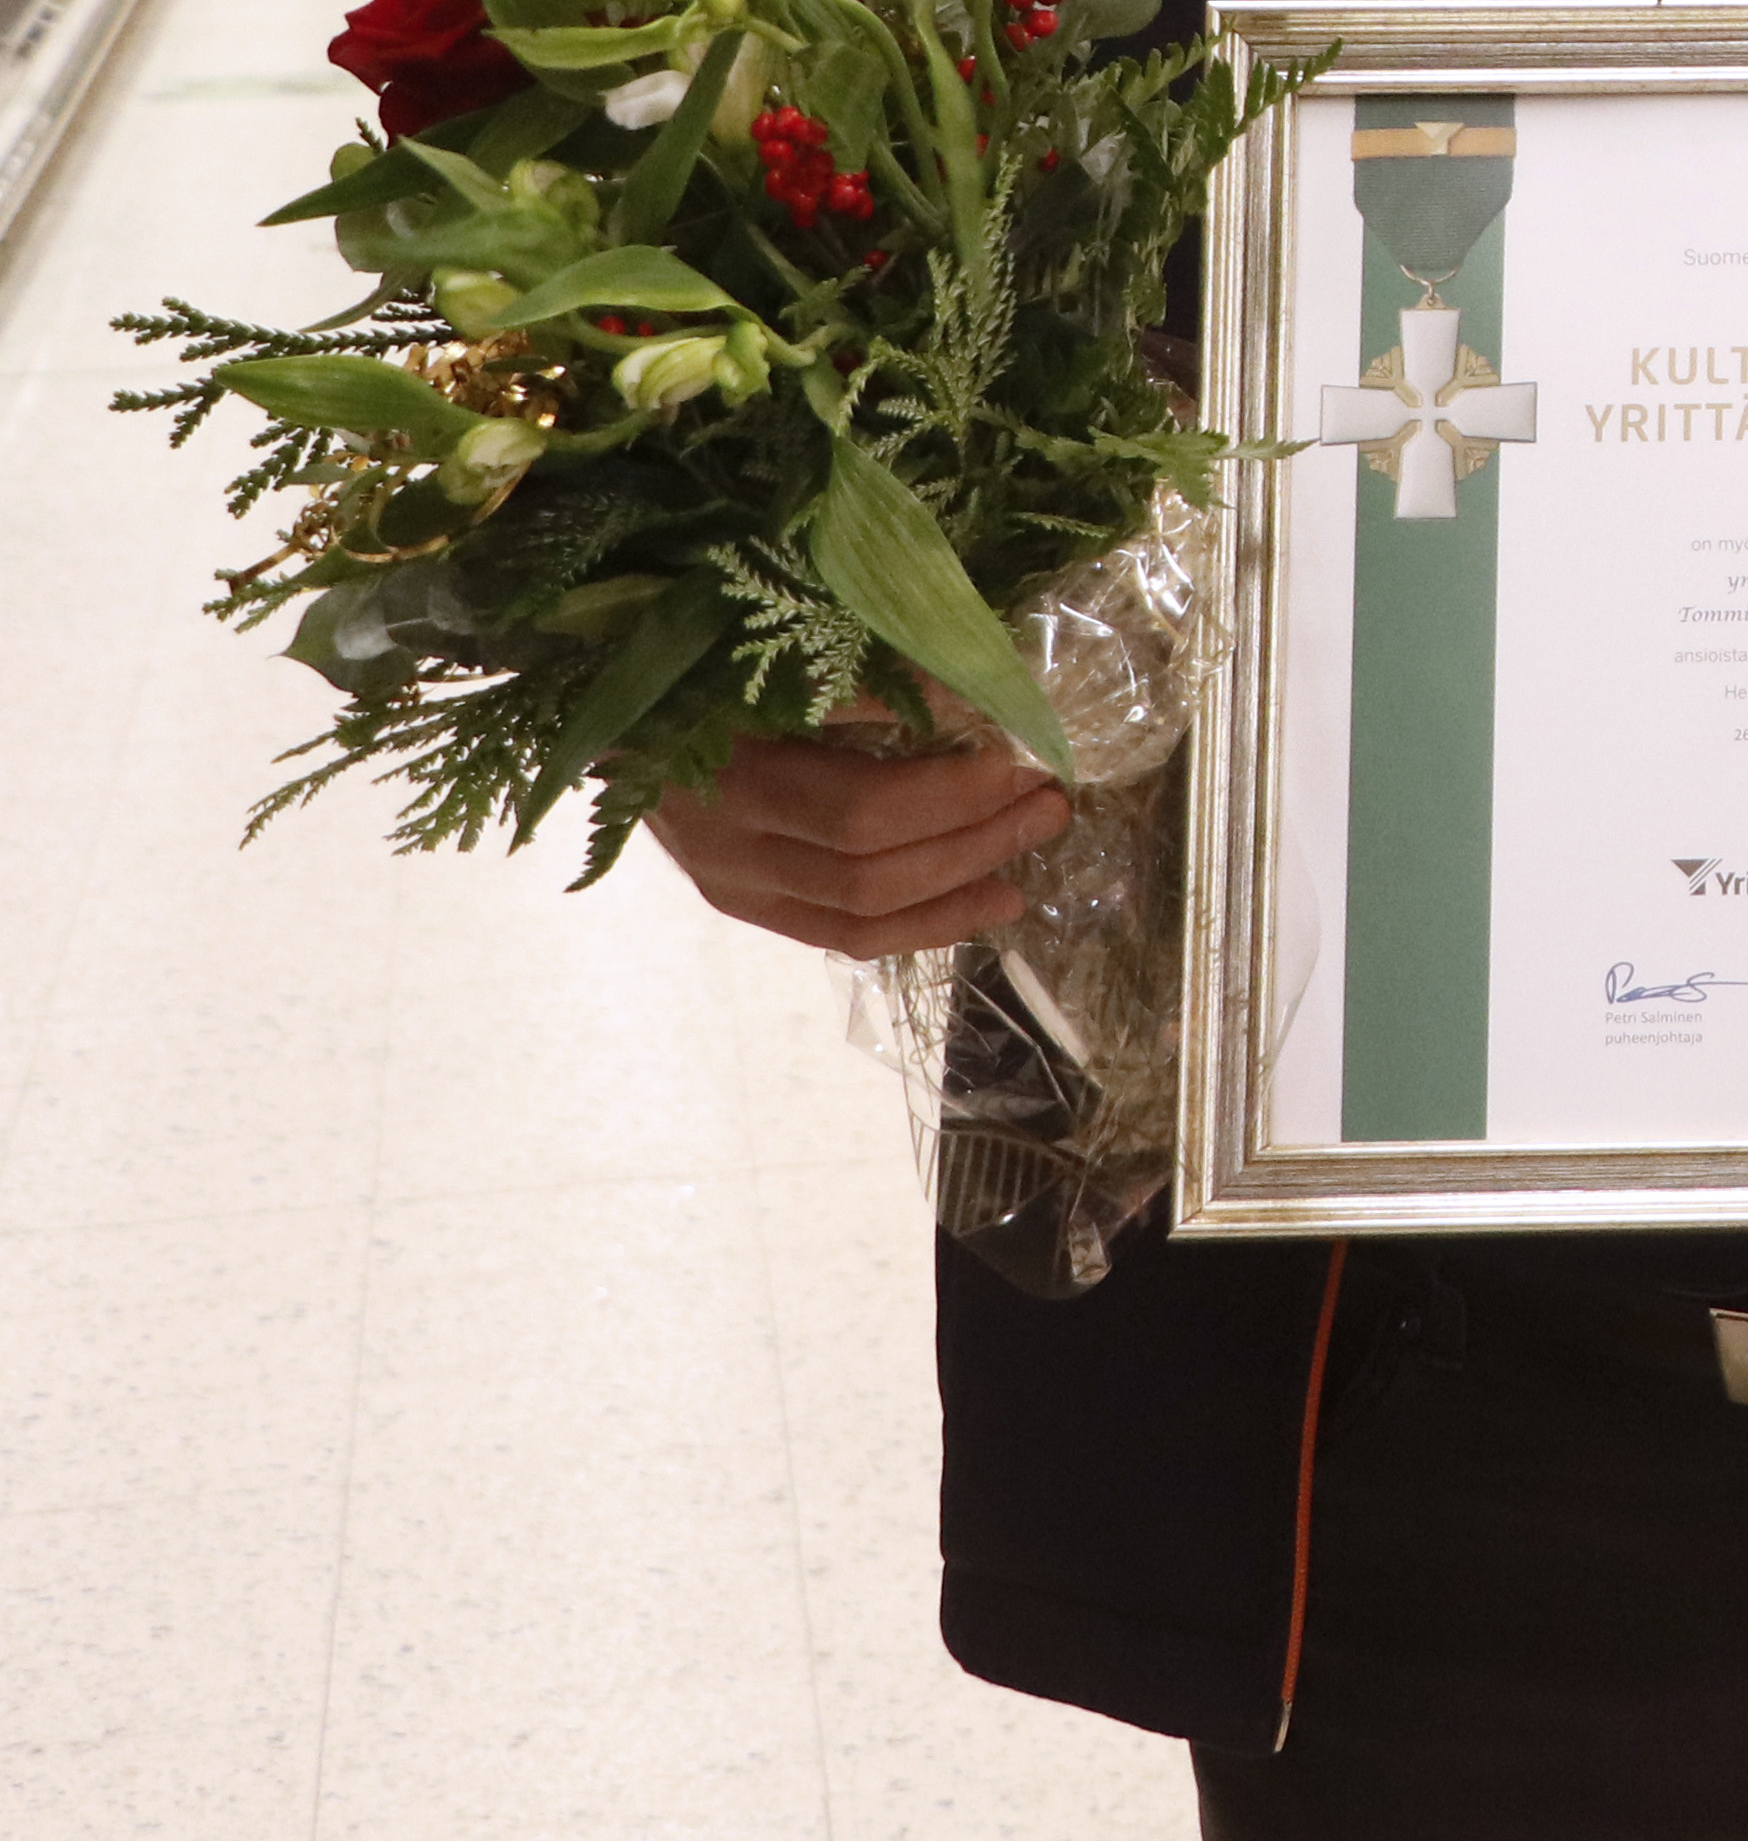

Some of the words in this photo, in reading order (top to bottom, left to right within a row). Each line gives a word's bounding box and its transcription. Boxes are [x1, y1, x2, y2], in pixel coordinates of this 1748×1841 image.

[1691, 538, 1712, 551] on
[1605, 1011, 1637, 1024] Petri
[1641, 1010, 1703, 1024] Salminen
[1605, 1030, 1703, 1046] puheenjohtaja
